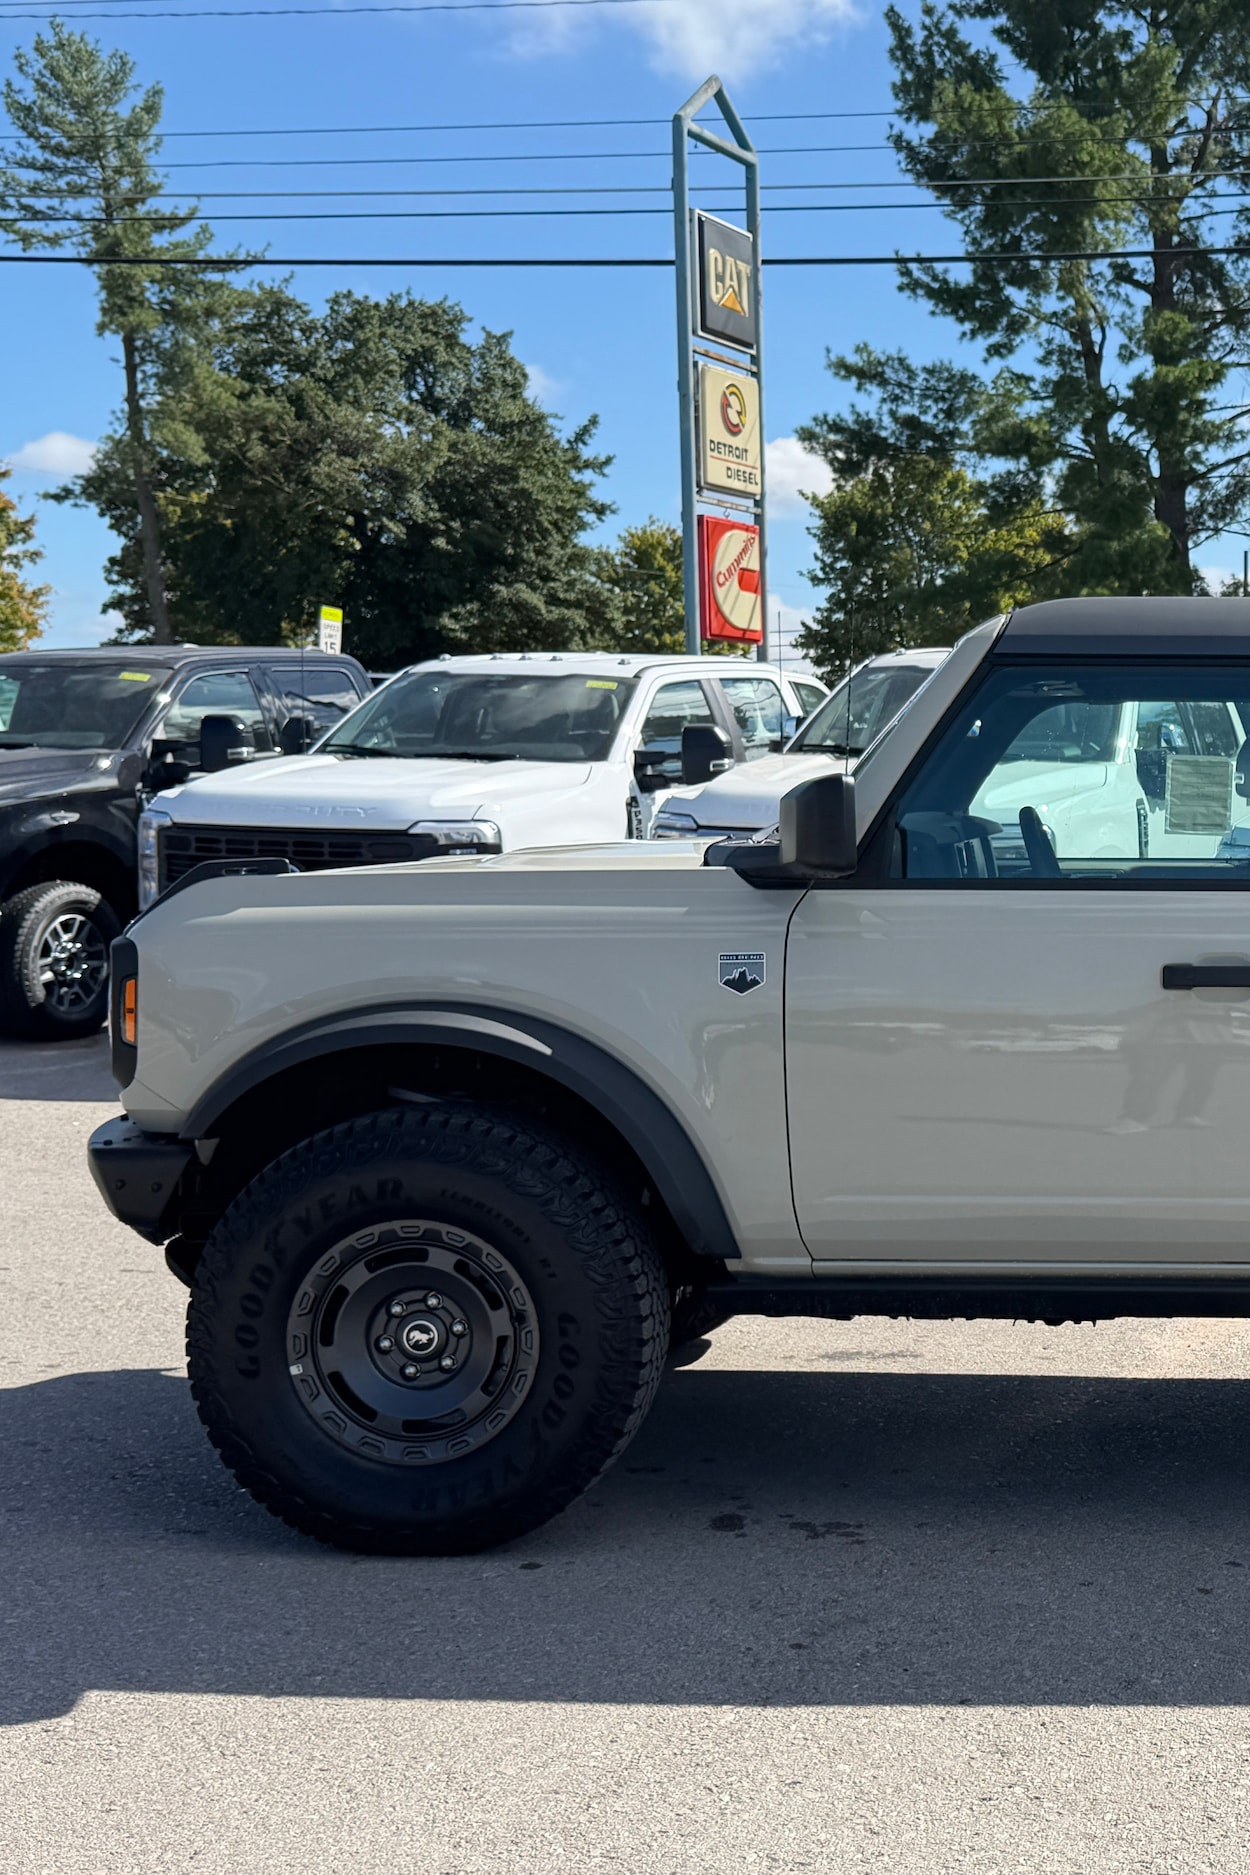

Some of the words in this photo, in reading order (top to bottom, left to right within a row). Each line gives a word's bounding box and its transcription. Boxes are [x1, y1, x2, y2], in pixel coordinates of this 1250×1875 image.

[709, 247, 752, 318] CAT
[709, 438, 749, 462] DETROIT
[726, 465, 759, 486] DIESEL
[715, 535, 756, 589] Cummins
[324, 640, 337, 655] 15
